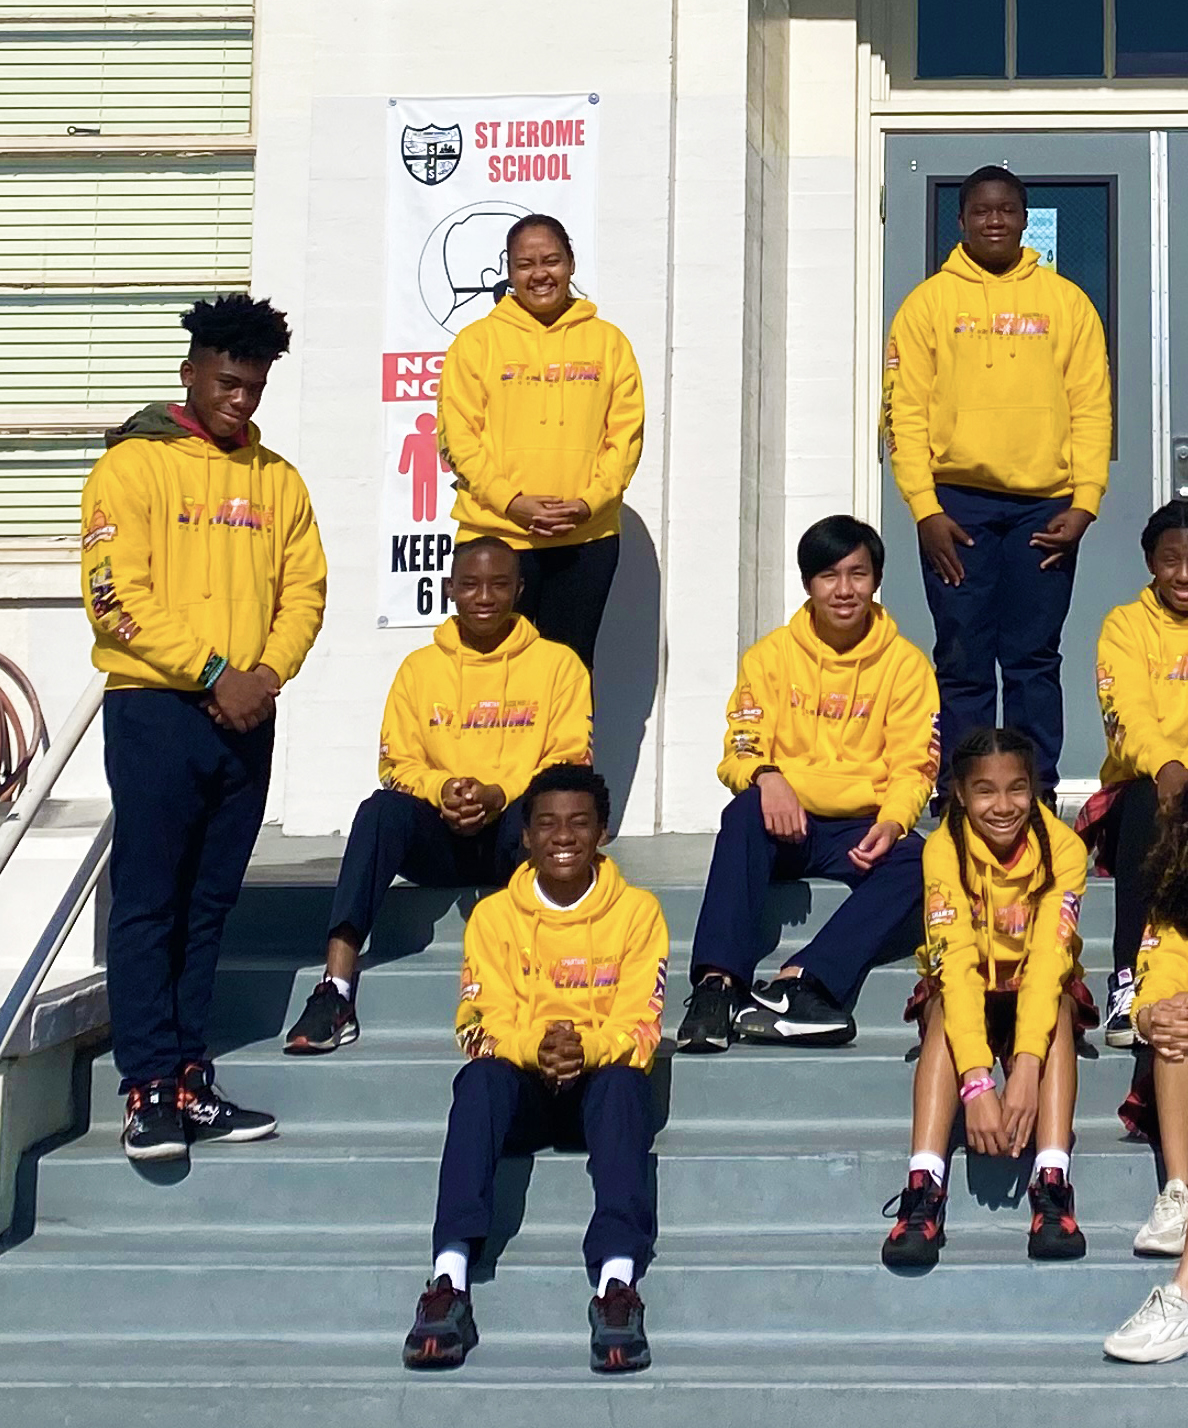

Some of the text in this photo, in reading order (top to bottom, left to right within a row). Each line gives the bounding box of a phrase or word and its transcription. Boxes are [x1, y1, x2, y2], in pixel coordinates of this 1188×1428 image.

[475, 121, 501, 149] ST
[506, 119, 585, 149] JEROME
[488, 153, 572, 183] SCHOOL
[391, 533, 452, 573] KEEP
[417, 576, 433, 616] 6
